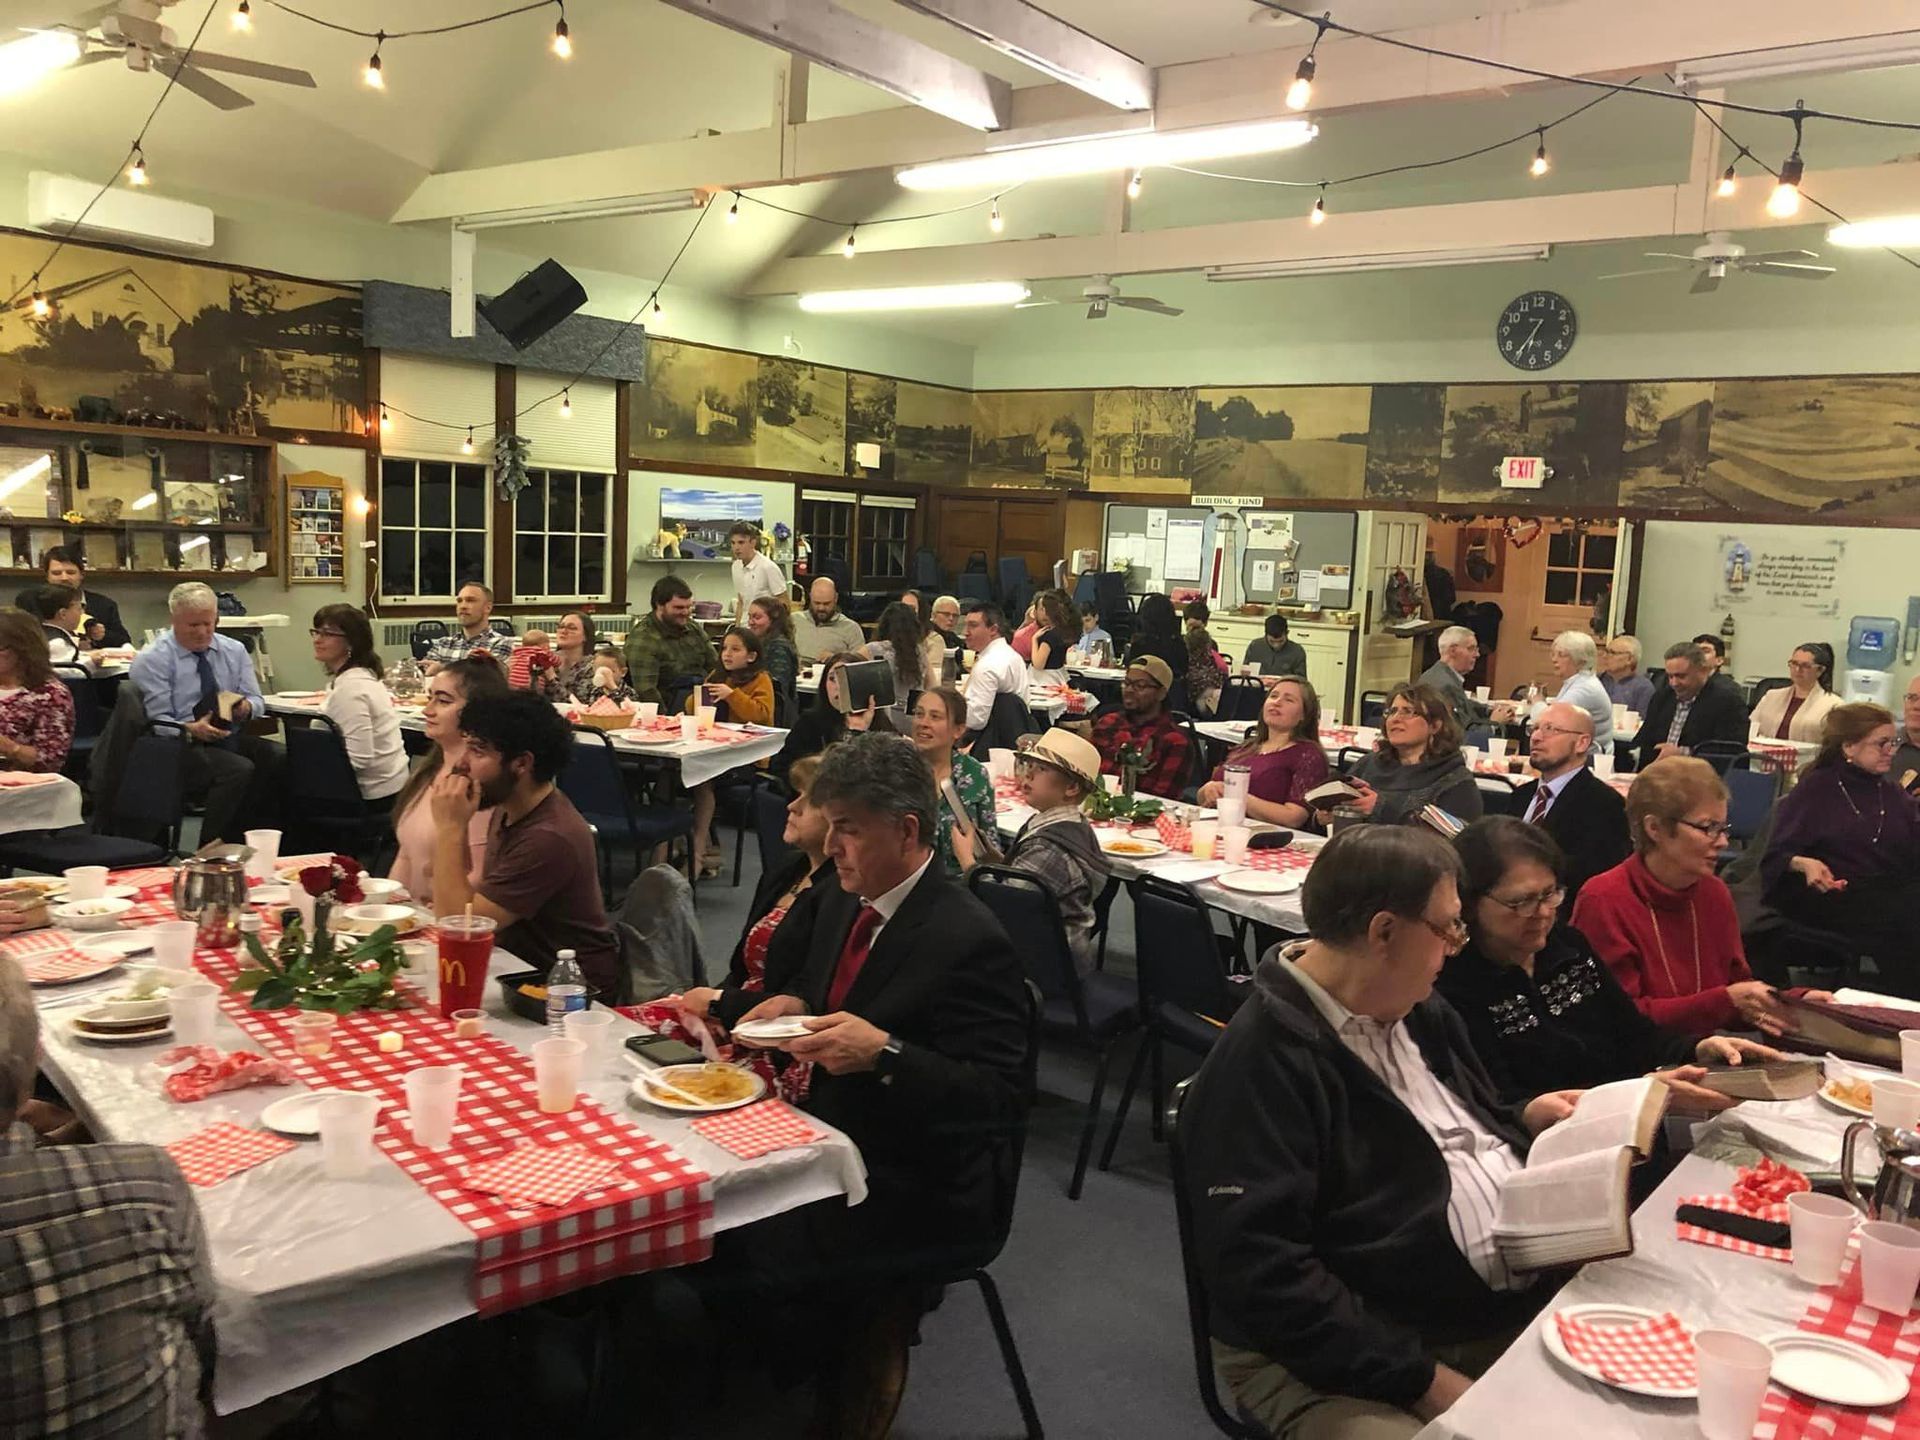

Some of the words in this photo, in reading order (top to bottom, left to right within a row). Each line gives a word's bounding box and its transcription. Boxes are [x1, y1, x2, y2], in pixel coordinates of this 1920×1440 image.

[1520, 301, 1529, 312] 11
[1533, 296, 1545, 307] 12
[1508, 313, 1520, 323] 10
[1559, 310, 1567, 320] 2
[1502, 326, 1510, 336] 9
[1562, 325, 1570, 335] 3
[1505, 341, 1513, 351] 8
[1554, 340, 1563, 350] 4
[1528, 354, 1537, 365] 6
[1544, 351, 1551, 361] 5
[1509, 459, 1537, 479] EXIT
[1195, 497, 1233, 505] BUILDING
